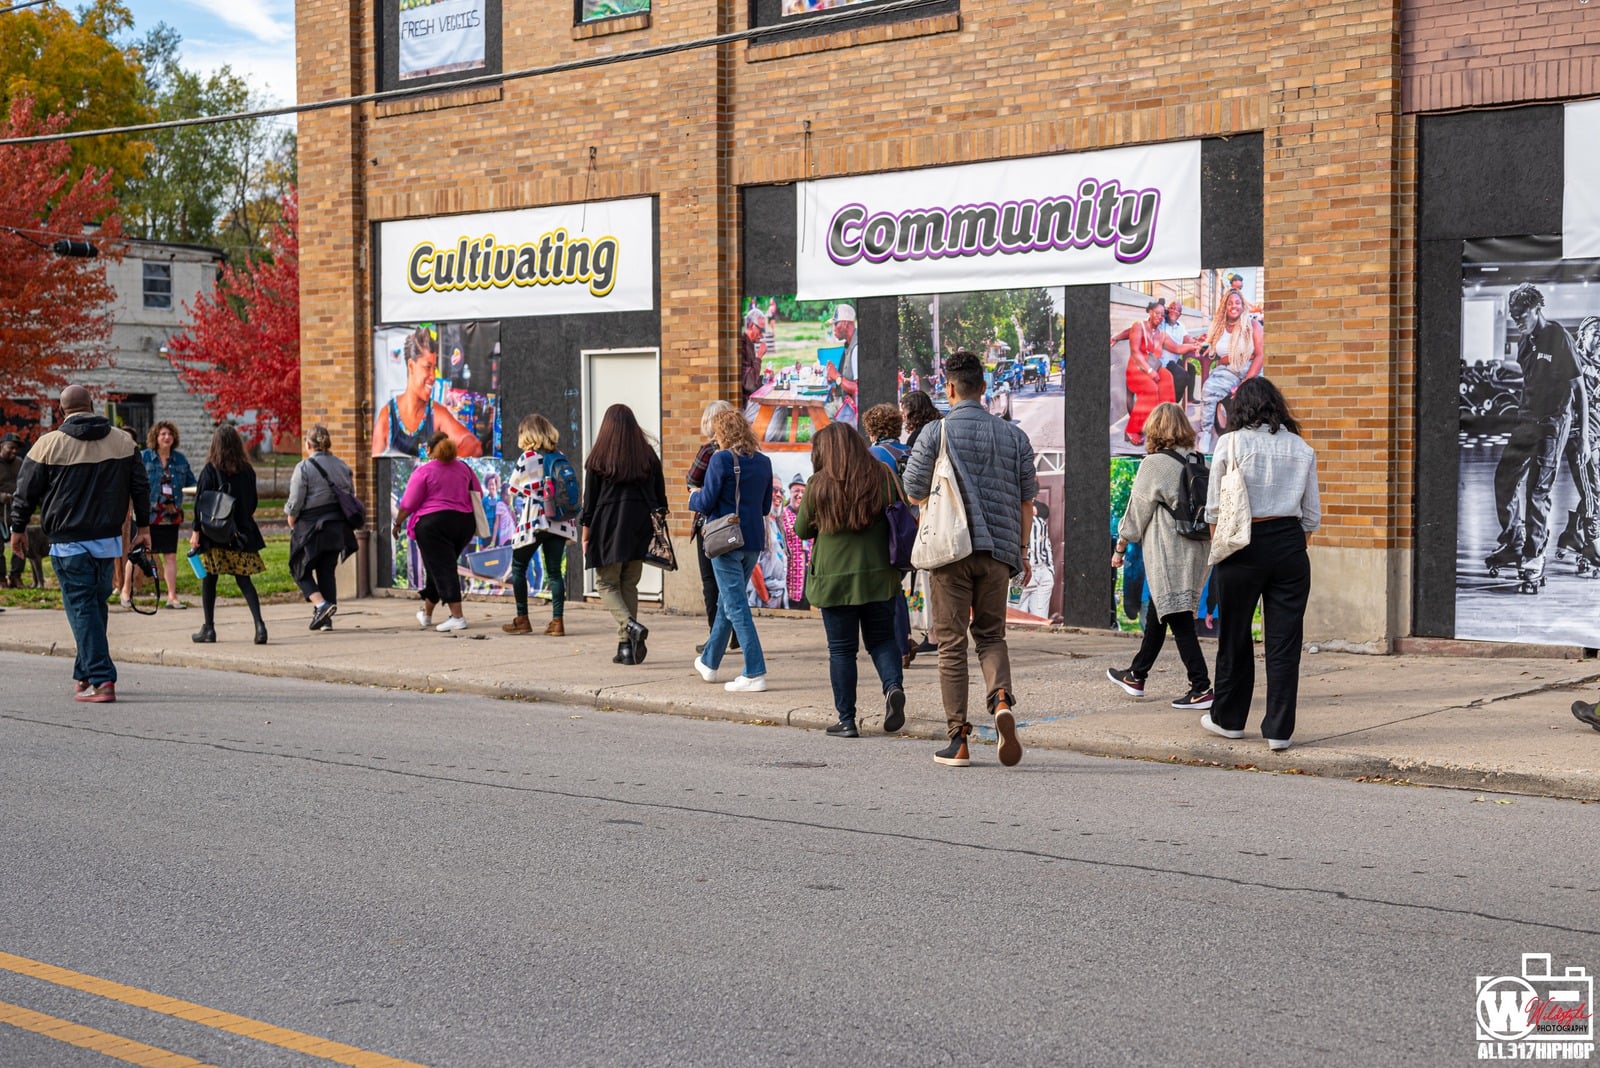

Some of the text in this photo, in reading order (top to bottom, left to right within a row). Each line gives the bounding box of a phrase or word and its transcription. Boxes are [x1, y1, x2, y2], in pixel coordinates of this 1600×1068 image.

[401, 9, 481, 40] FRESH VEGGIES
[826, 176, 1161, 264] Community
[407, 226, 620, 297] Cultivating
